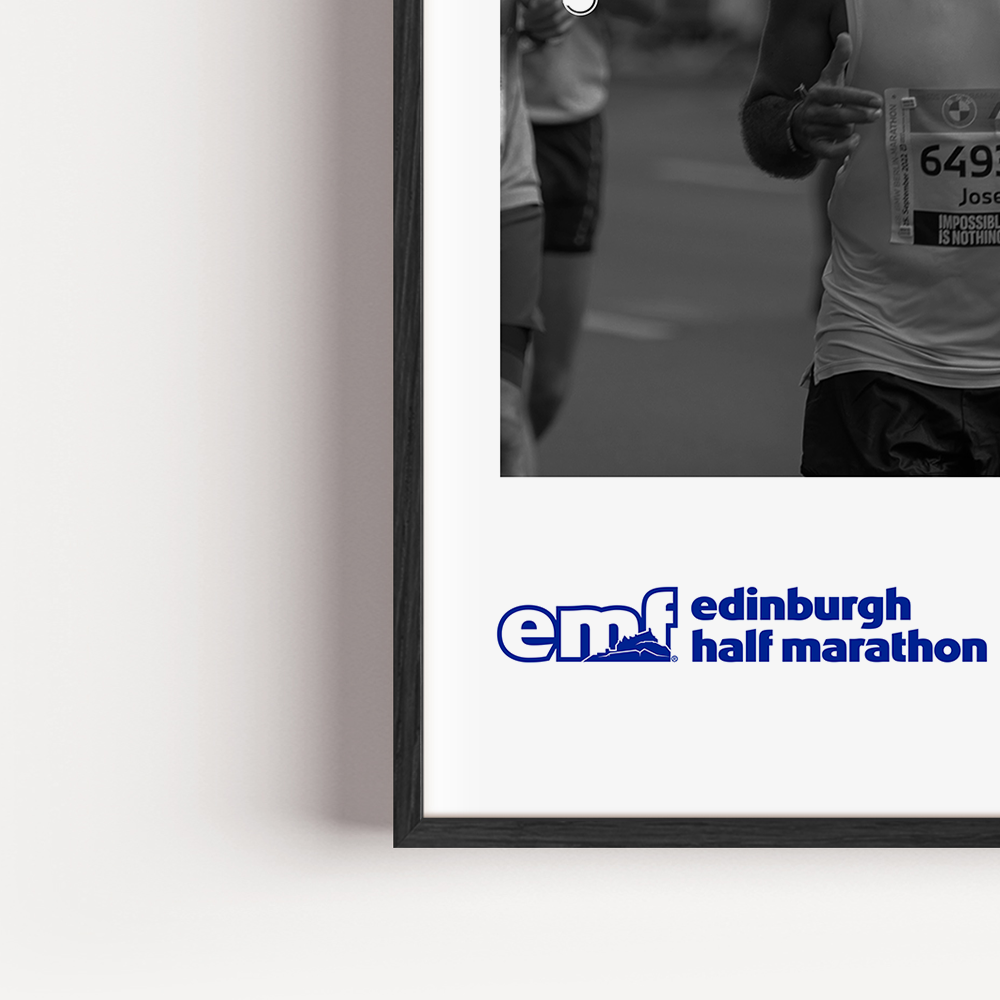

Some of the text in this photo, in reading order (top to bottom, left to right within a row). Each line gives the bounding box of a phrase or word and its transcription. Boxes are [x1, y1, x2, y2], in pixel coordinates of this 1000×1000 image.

[938, 229, 951, 246] IS
[496, 586, 679, 663] emf
[690, 586, 912, 630] edinburgh
[691, 628, 988, 663] half marathon
